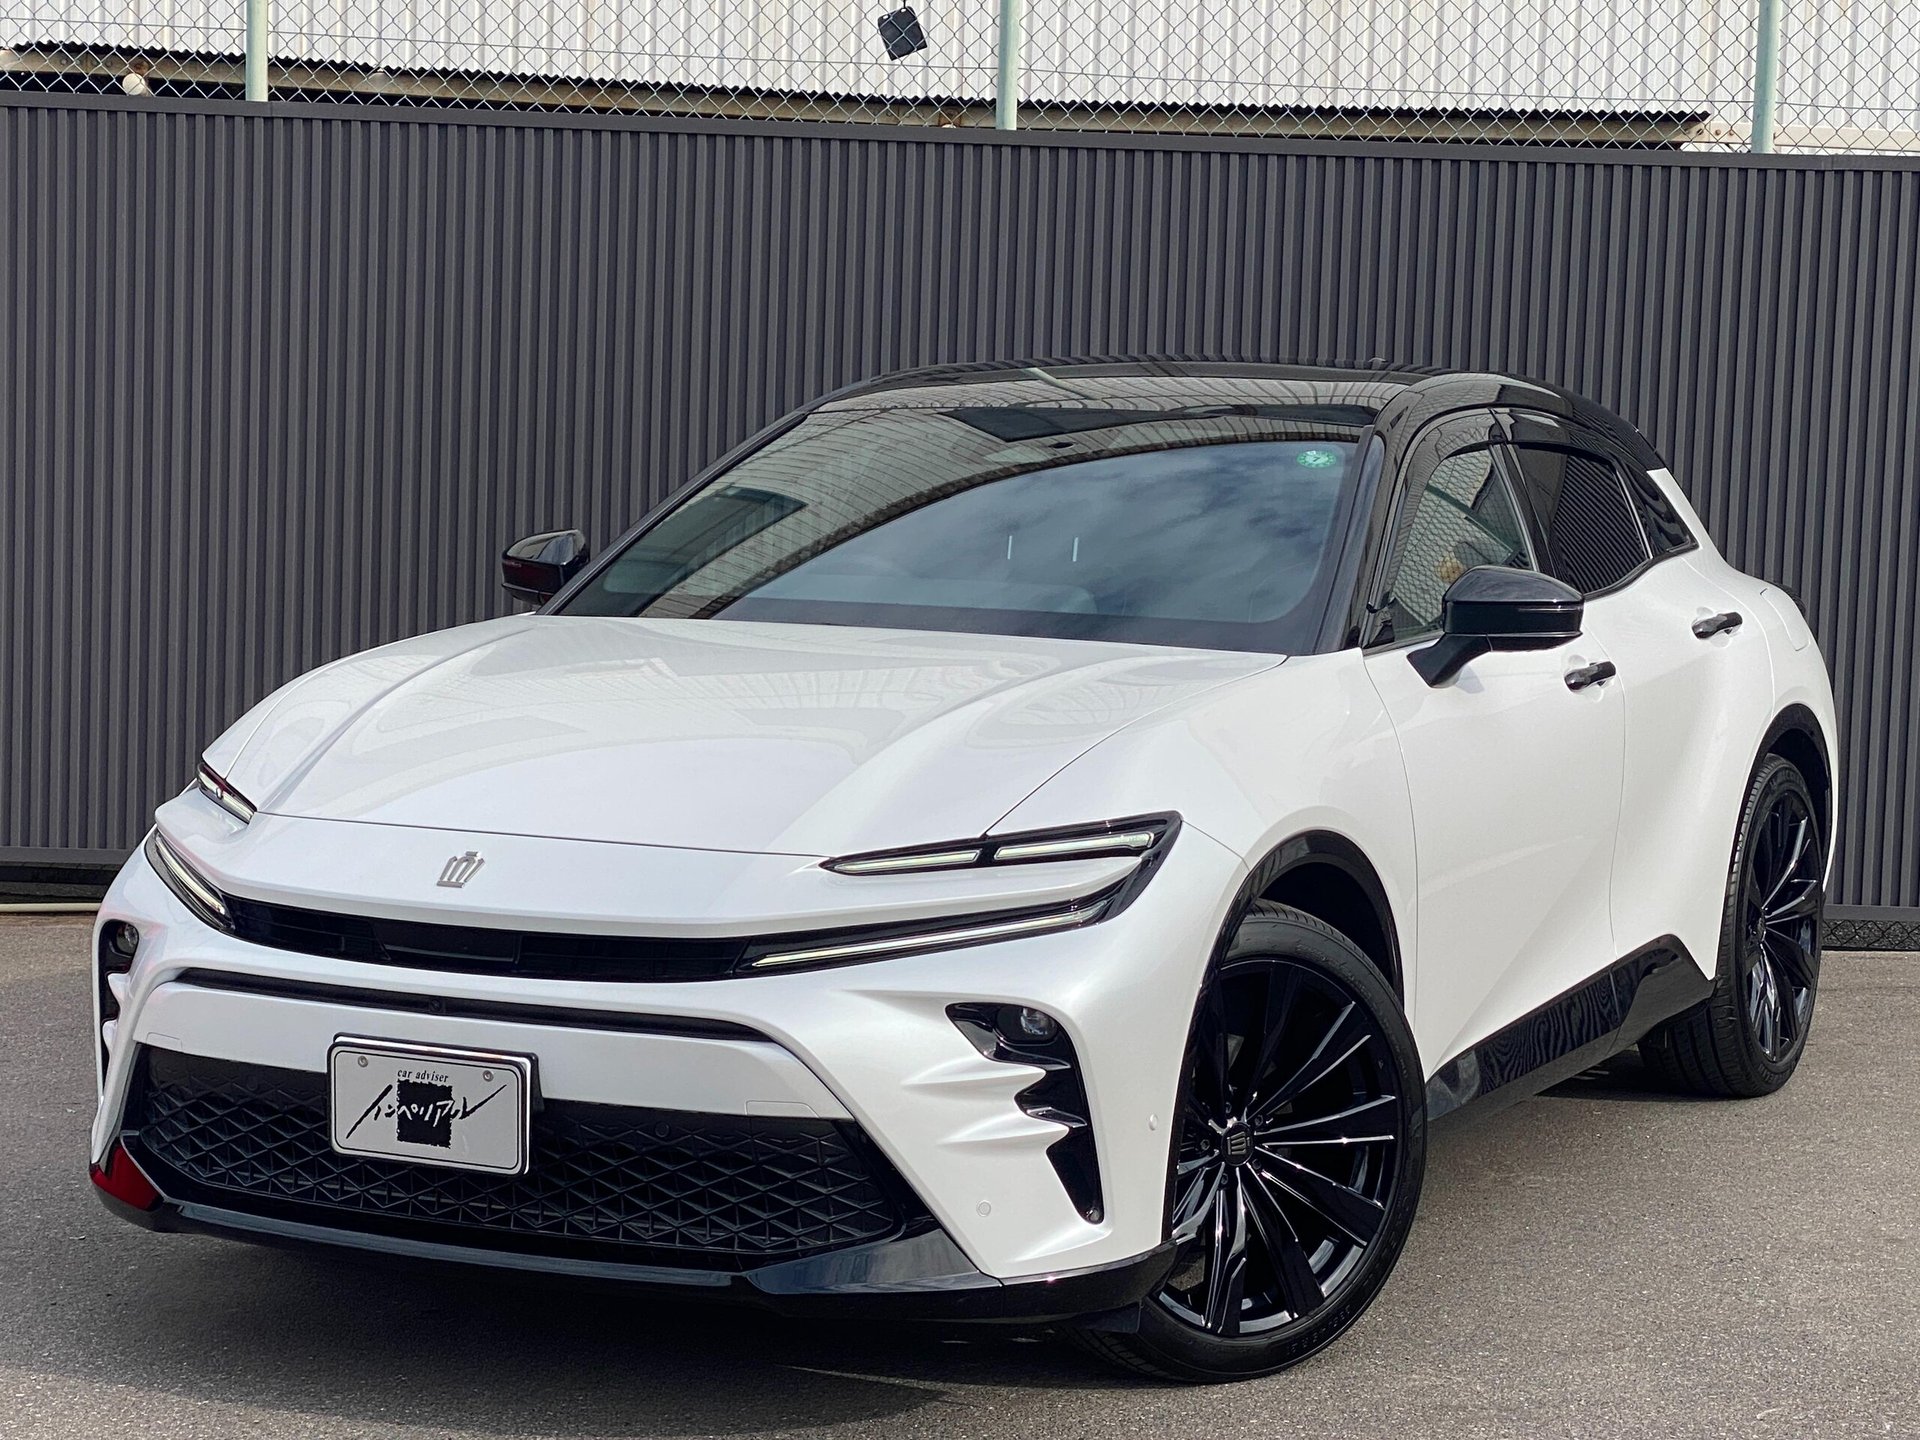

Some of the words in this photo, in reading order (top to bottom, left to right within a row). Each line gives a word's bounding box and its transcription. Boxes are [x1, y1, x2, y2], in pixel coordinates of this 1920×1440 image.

[397, 1068, 413, 1079] car
[415, 1069, 449, 1083] adviser
[346, 1084, 507, 1139] インペリアル
